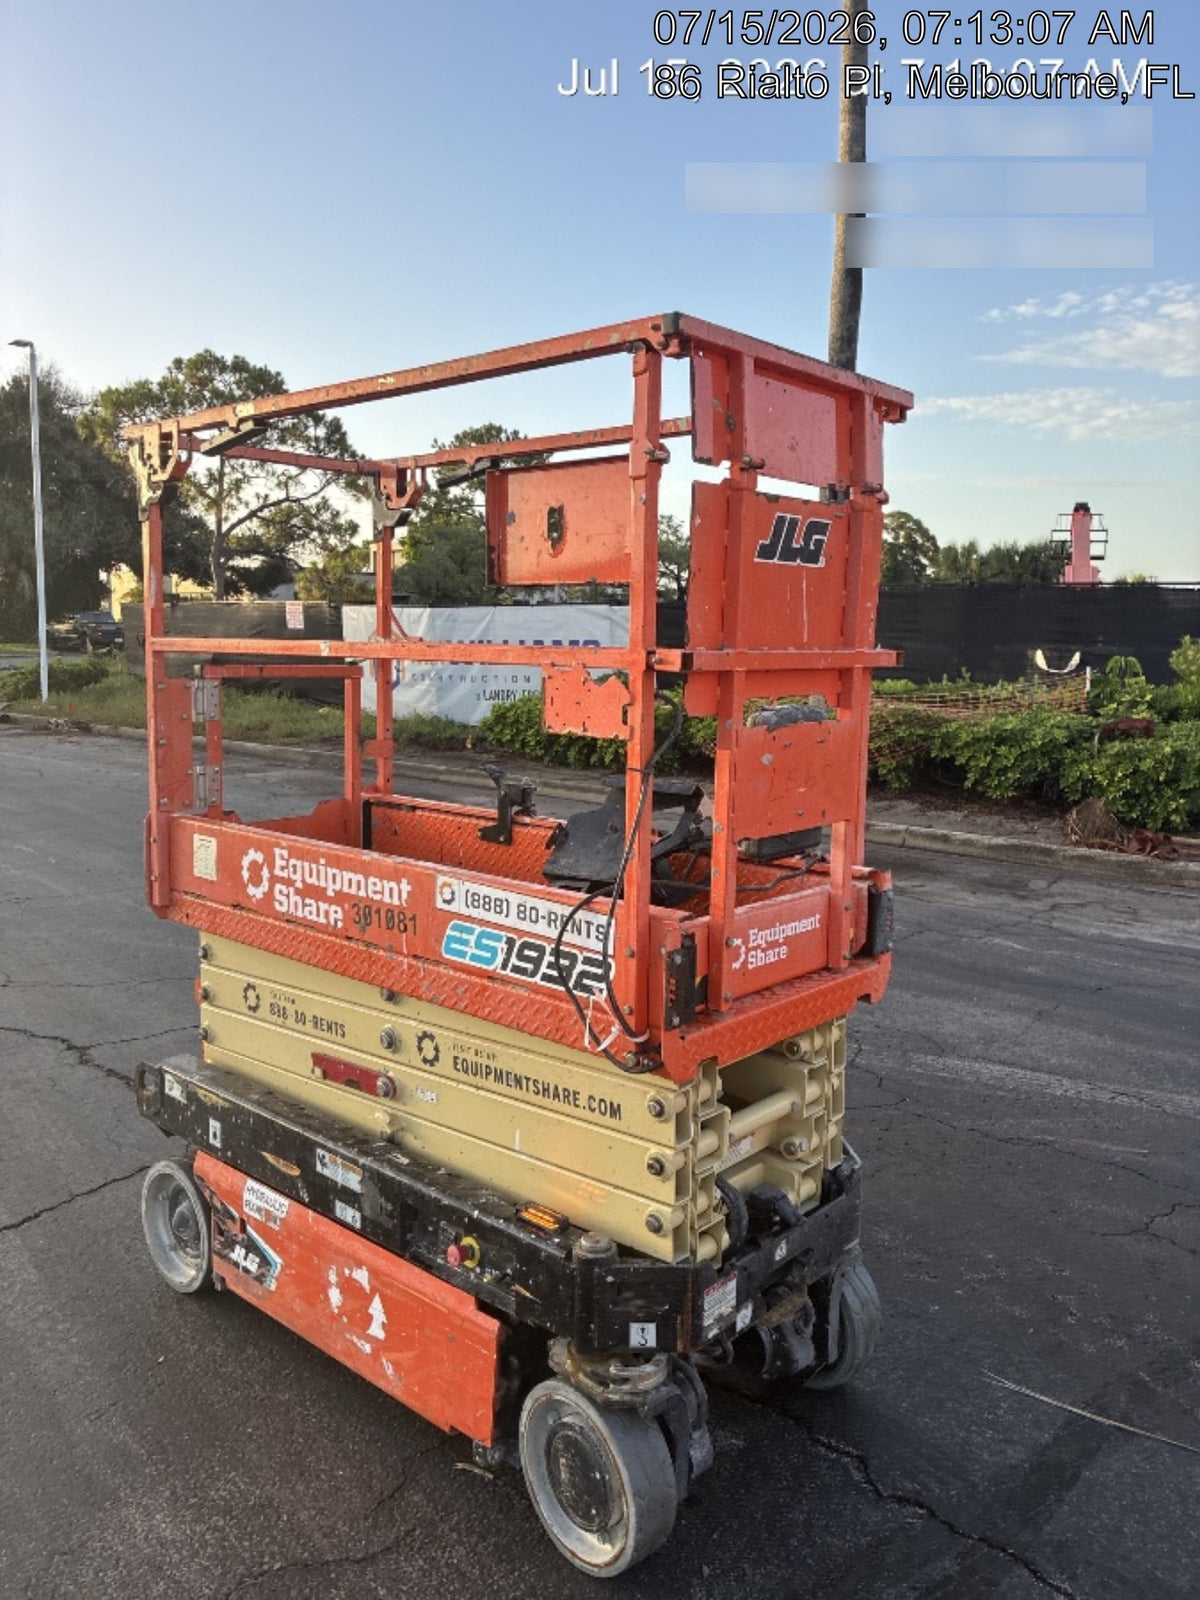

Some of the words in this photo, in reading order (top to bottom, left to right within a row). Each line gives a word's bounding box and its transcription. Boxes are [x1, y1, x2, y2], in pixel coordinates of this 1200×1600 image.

[754, 512, 832, 568] JLG
[273, 848, 412, 907] Equipment
[273, 883, 343, 929] Share
[351, 902, 418, 936] 301081
[465, 889, 510, 918] (888)
[517, 903, 608, 943] 80-RENTS
[748, 913, 821, 948] Equipment
[442, 920, 616, 999] ES1932
[748, 945, 788, 970] Share
[452, 1055, 622, 1121] EQUIPMENTSHARE.COM
